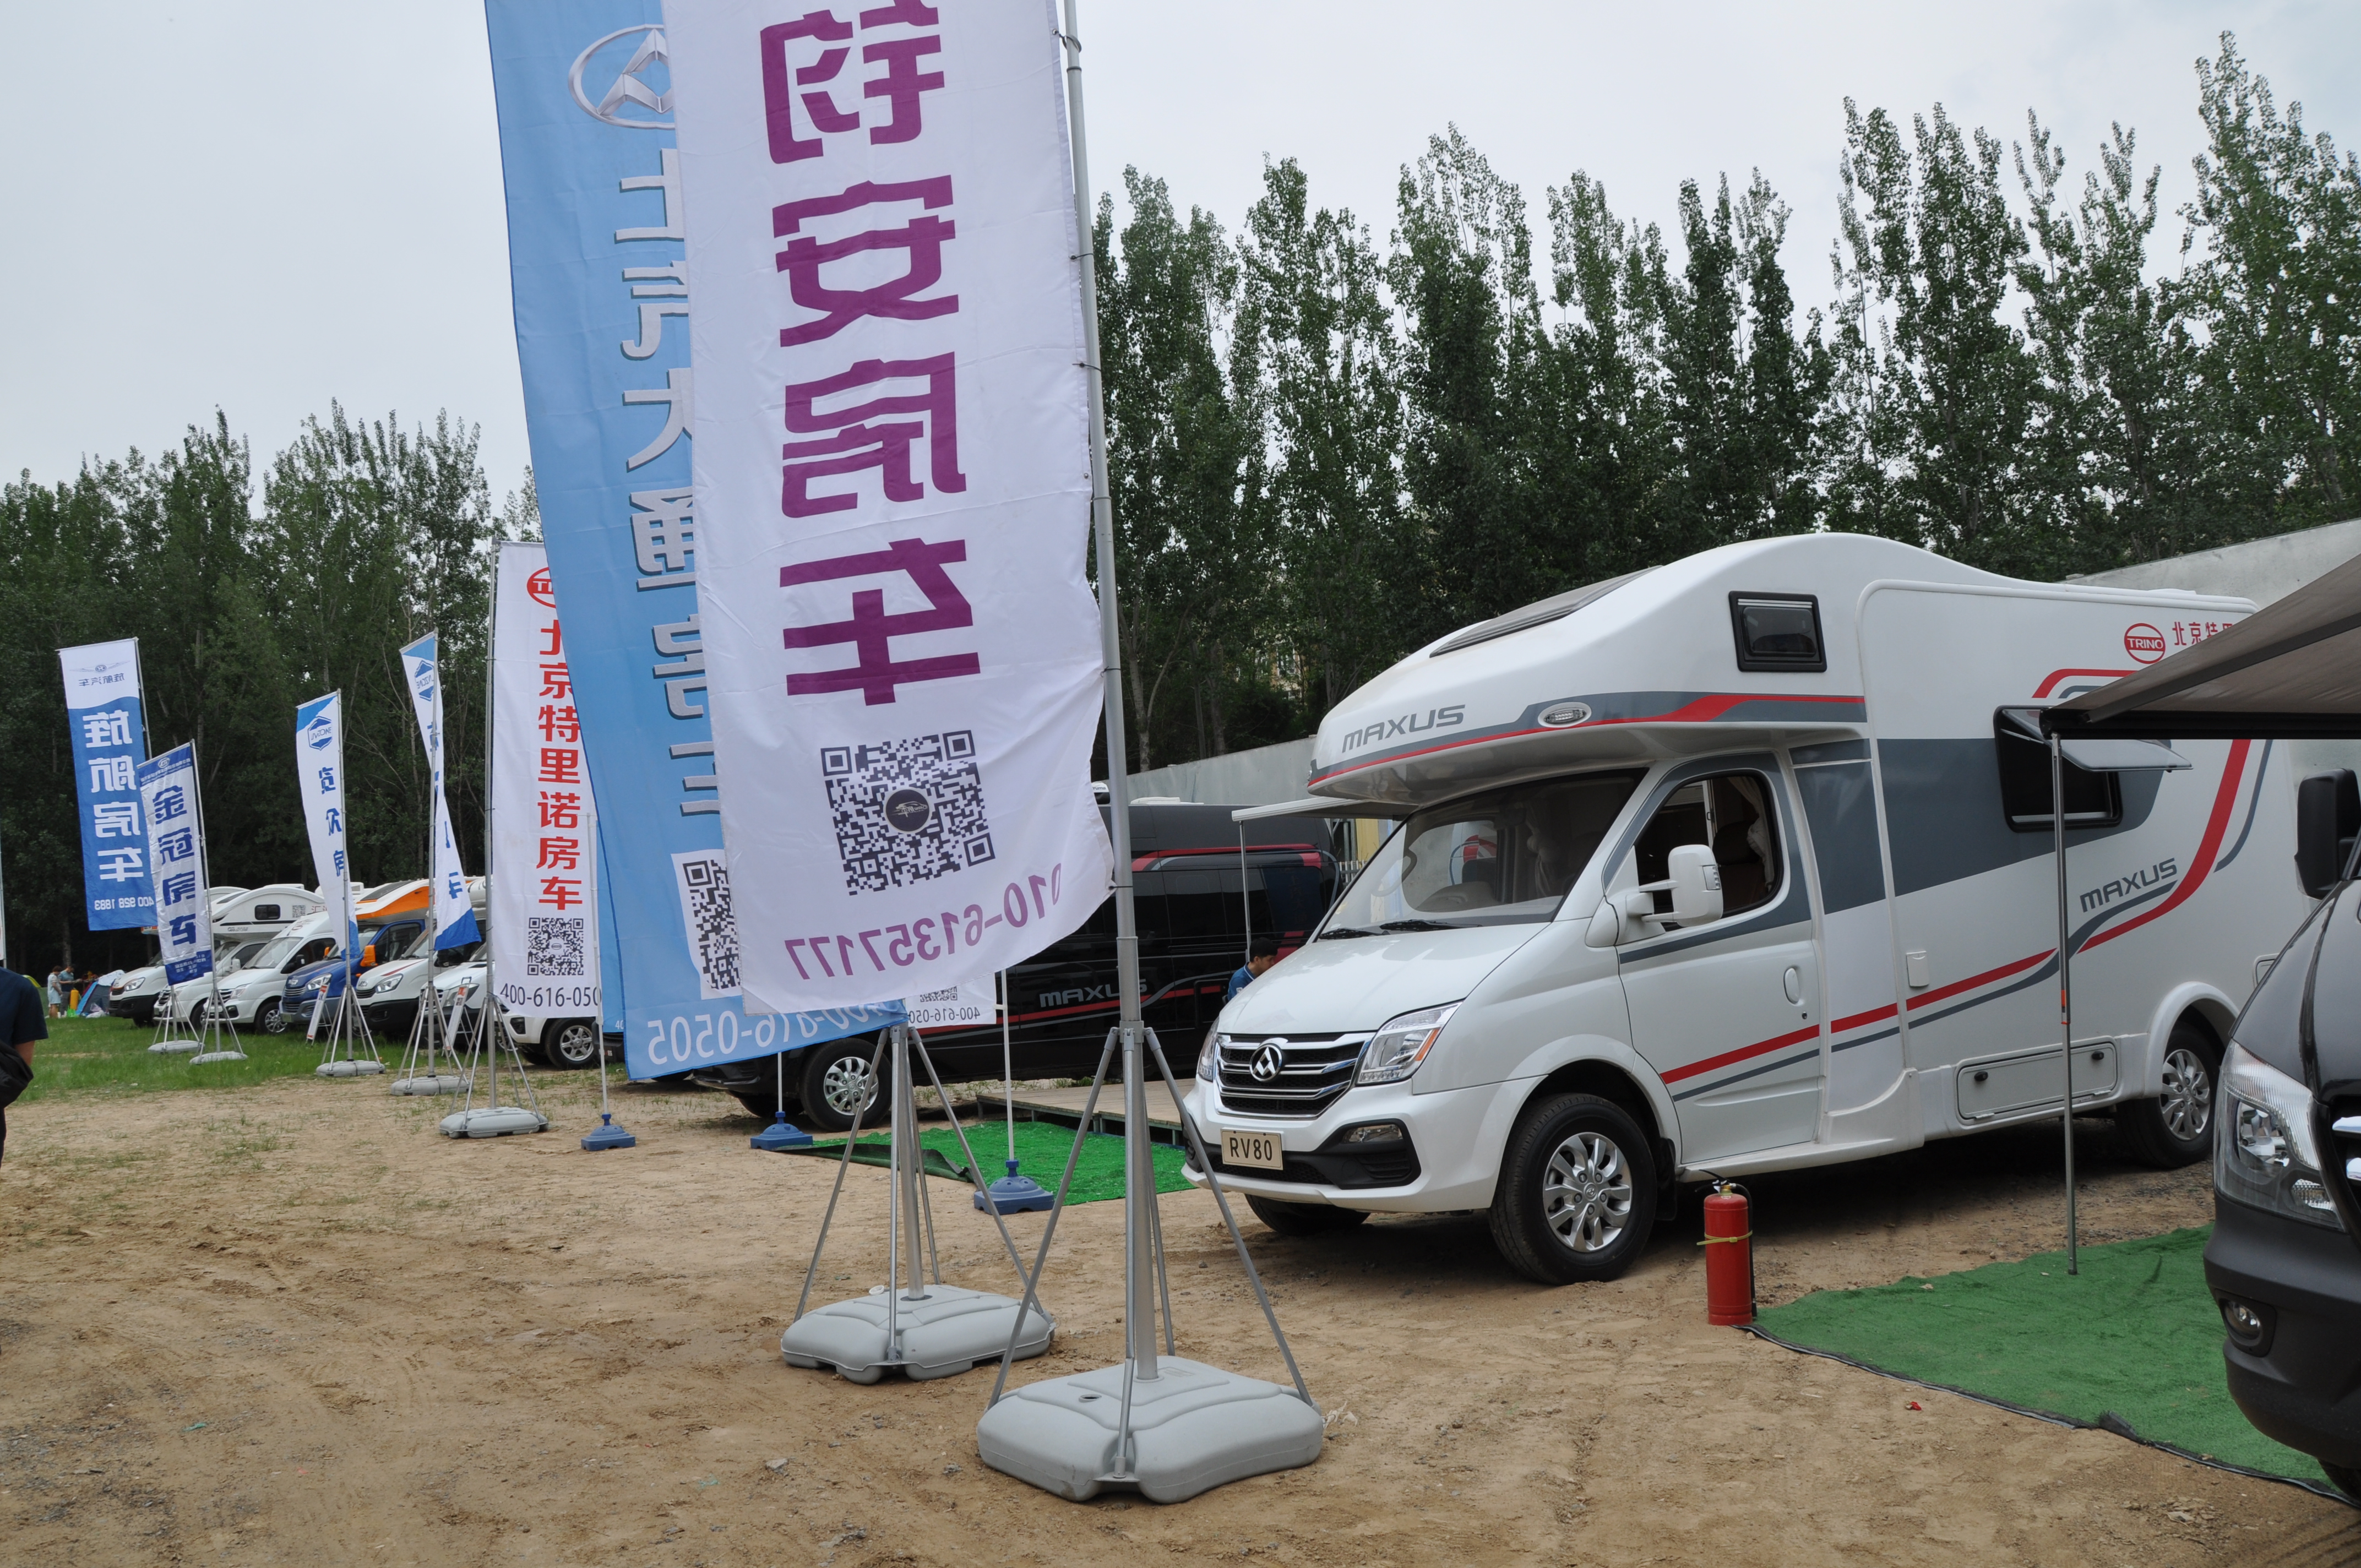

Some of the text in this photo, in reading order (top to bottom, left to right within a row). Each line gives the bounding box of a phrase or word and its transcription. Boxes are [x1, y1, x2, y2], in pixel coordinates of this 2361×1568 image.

[2127, 638, 2163, 649] TRINO
[1342, 704, 1466, 753] MAXUS
[318, 767, 344, 901] 览众房
[153, 785, 196, 946] 金冠房车
[2080, 857, 2177, 913] MAXUS
[1230, 1137, 1272, 1161] RV80
